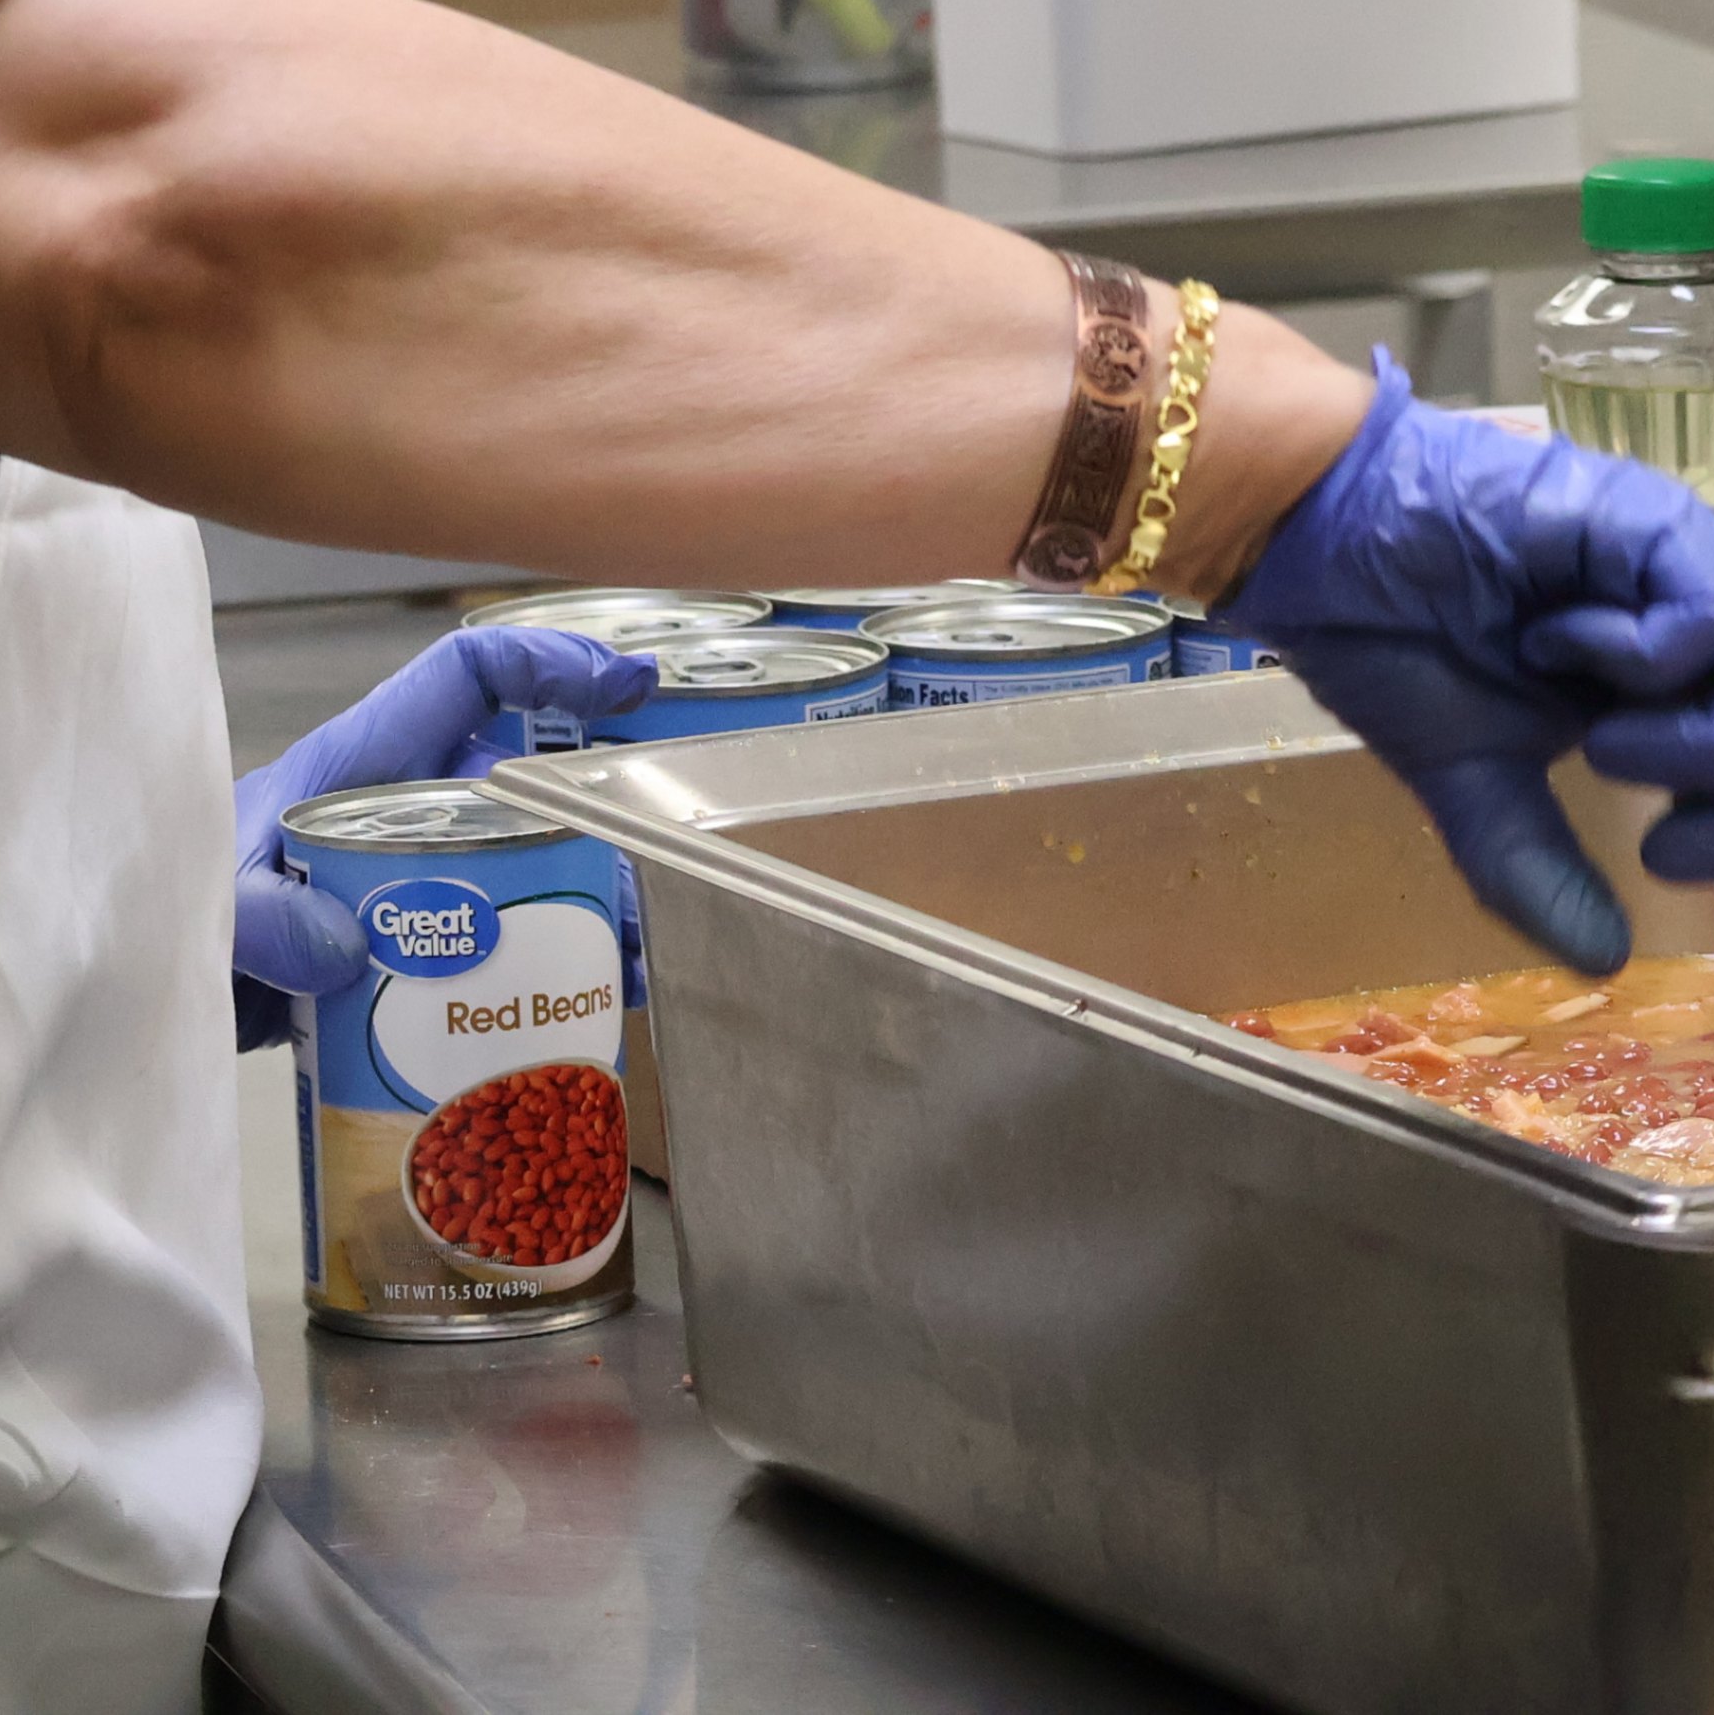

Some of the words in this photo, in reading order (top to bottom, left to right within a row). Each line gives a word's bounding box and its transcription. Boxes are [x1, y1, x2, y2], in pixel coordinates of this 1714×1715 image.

[919, 683, 969, 706] Facts
[372, 901, 477, 936] Great
[396, 934, 477, 958] Value
[446, 996, 521, 1035] Red
[532, 984, 613, 1027] Beans
[385, 1283, 409, 1300] NET
[412, 1283, 435, 1300] WT
[440, 1284, 471, 1301] 15.5
[474, 1282, 493, 1300] OZ
[497, 1278, 542, 1301] (439g)
